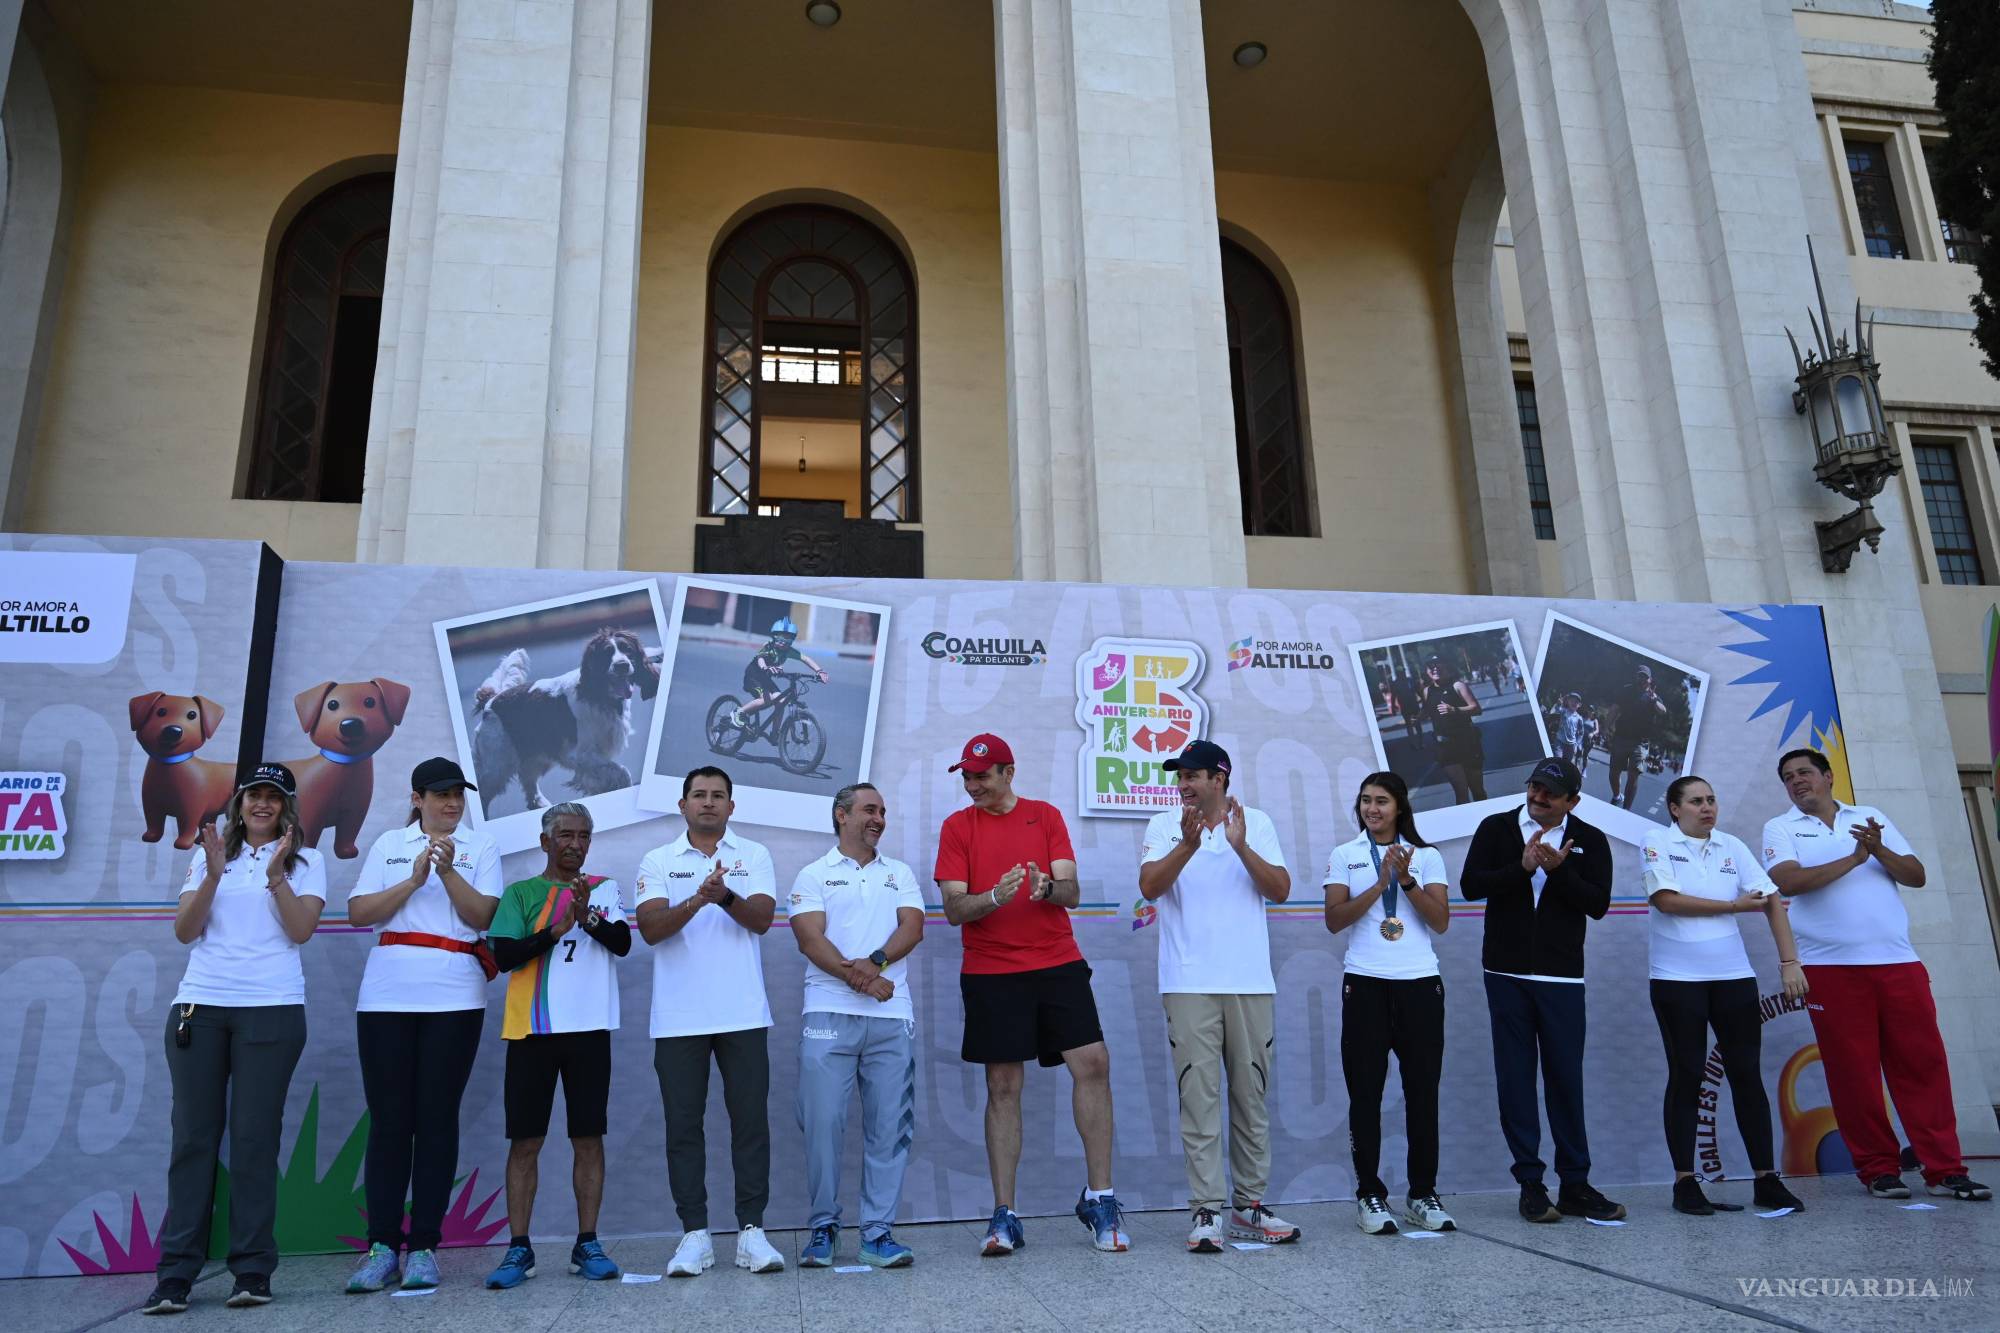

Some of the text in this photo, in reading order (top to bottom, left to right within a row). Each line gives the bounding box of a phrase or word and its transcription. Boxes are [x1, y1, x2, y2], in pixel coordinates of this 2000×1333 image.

[0, 601, 79, 612] OR AMOR A
[921, 631, 1047, 659] COAHUILA
[1256, 641, 1323, 652] POR AMOR A
[985, 656, 1026, 664] DELANTE
[1092, 704, 1193, 720] ANIVERSARIO
[46, 776, 61, 784] DE
[1114, 794, 1136, 805] RUTA
[1139, 796, 1150, 806] ES
[563, 939, 577, 962] 7
[1699, 1088, 1719, 1112] ES
[1697, 1114, 1722, 1174] CALLE
